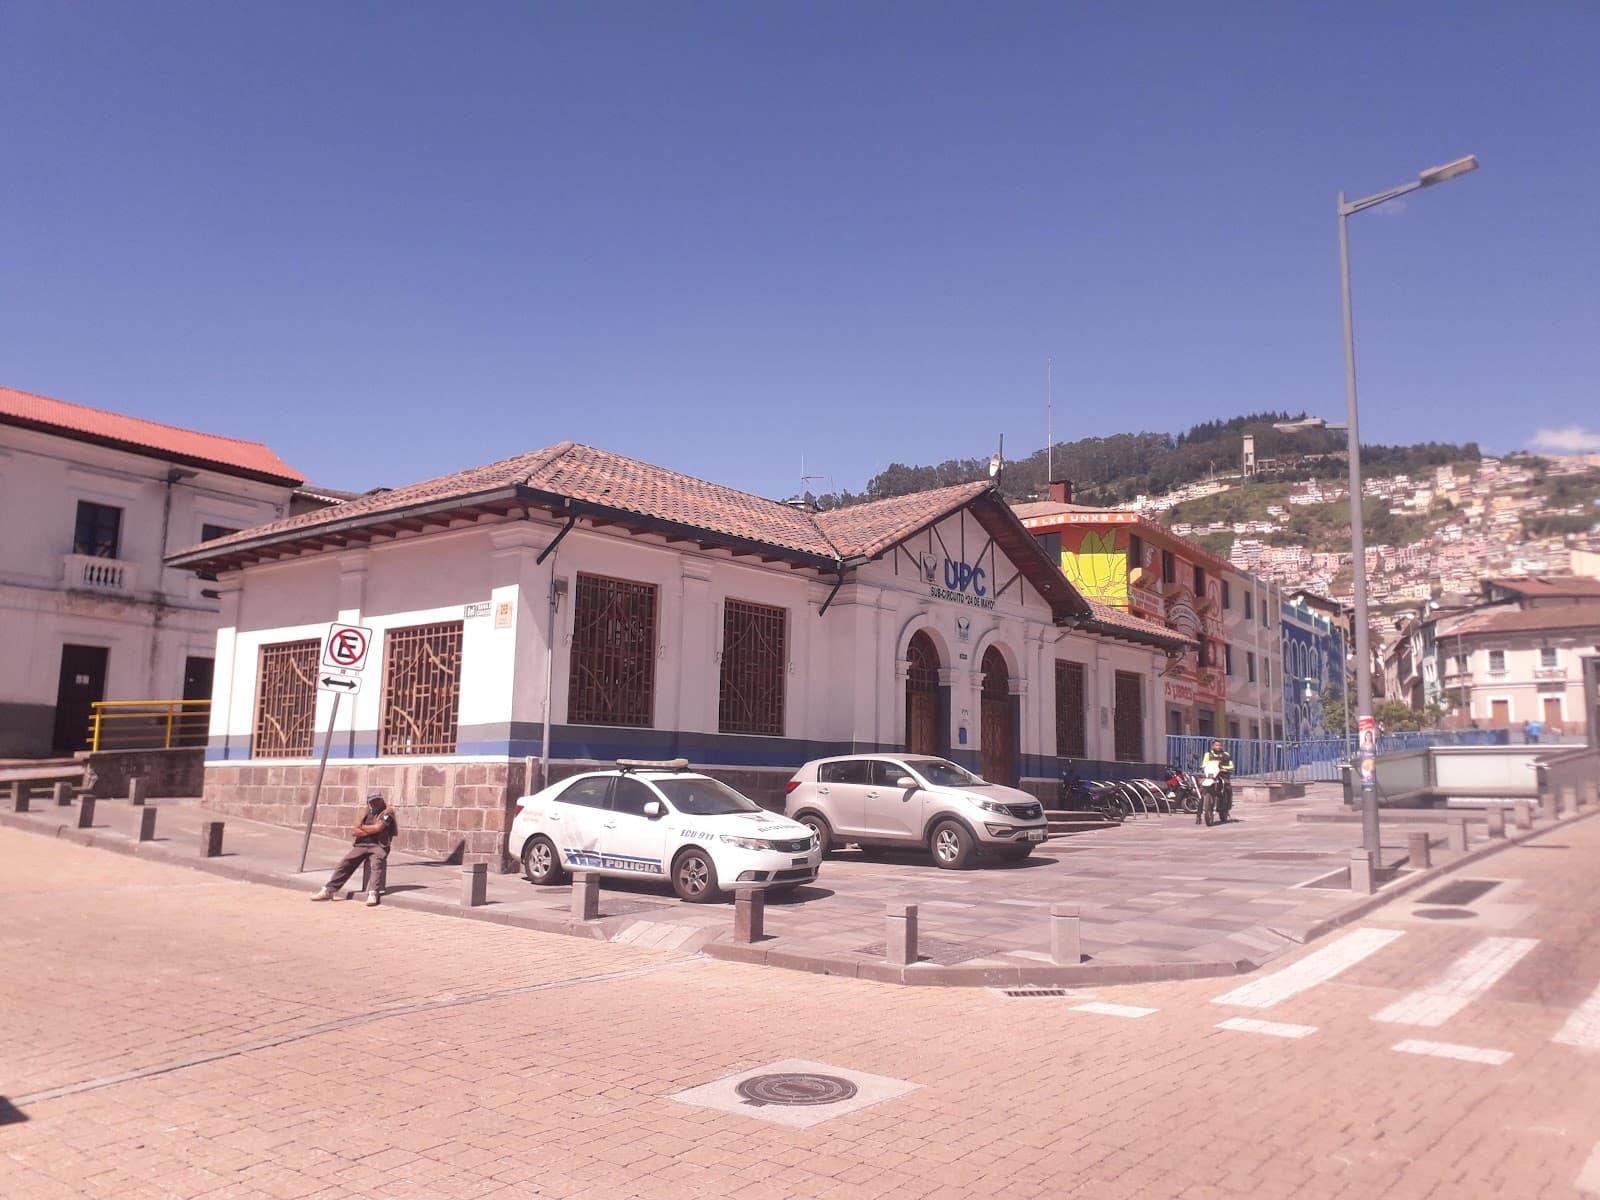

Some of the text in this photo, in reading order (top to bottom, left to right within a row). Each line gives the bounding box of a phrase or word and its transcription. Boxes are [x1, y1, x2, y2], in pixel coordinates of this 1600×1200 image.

[944, 558, 986, 597] UPC
[974, 596, 980, 607] DE
[337, 635, 358, 659] E
[680, 829, 715, 841] ECU 911
[605, 859, 658, 873] POLICIA
